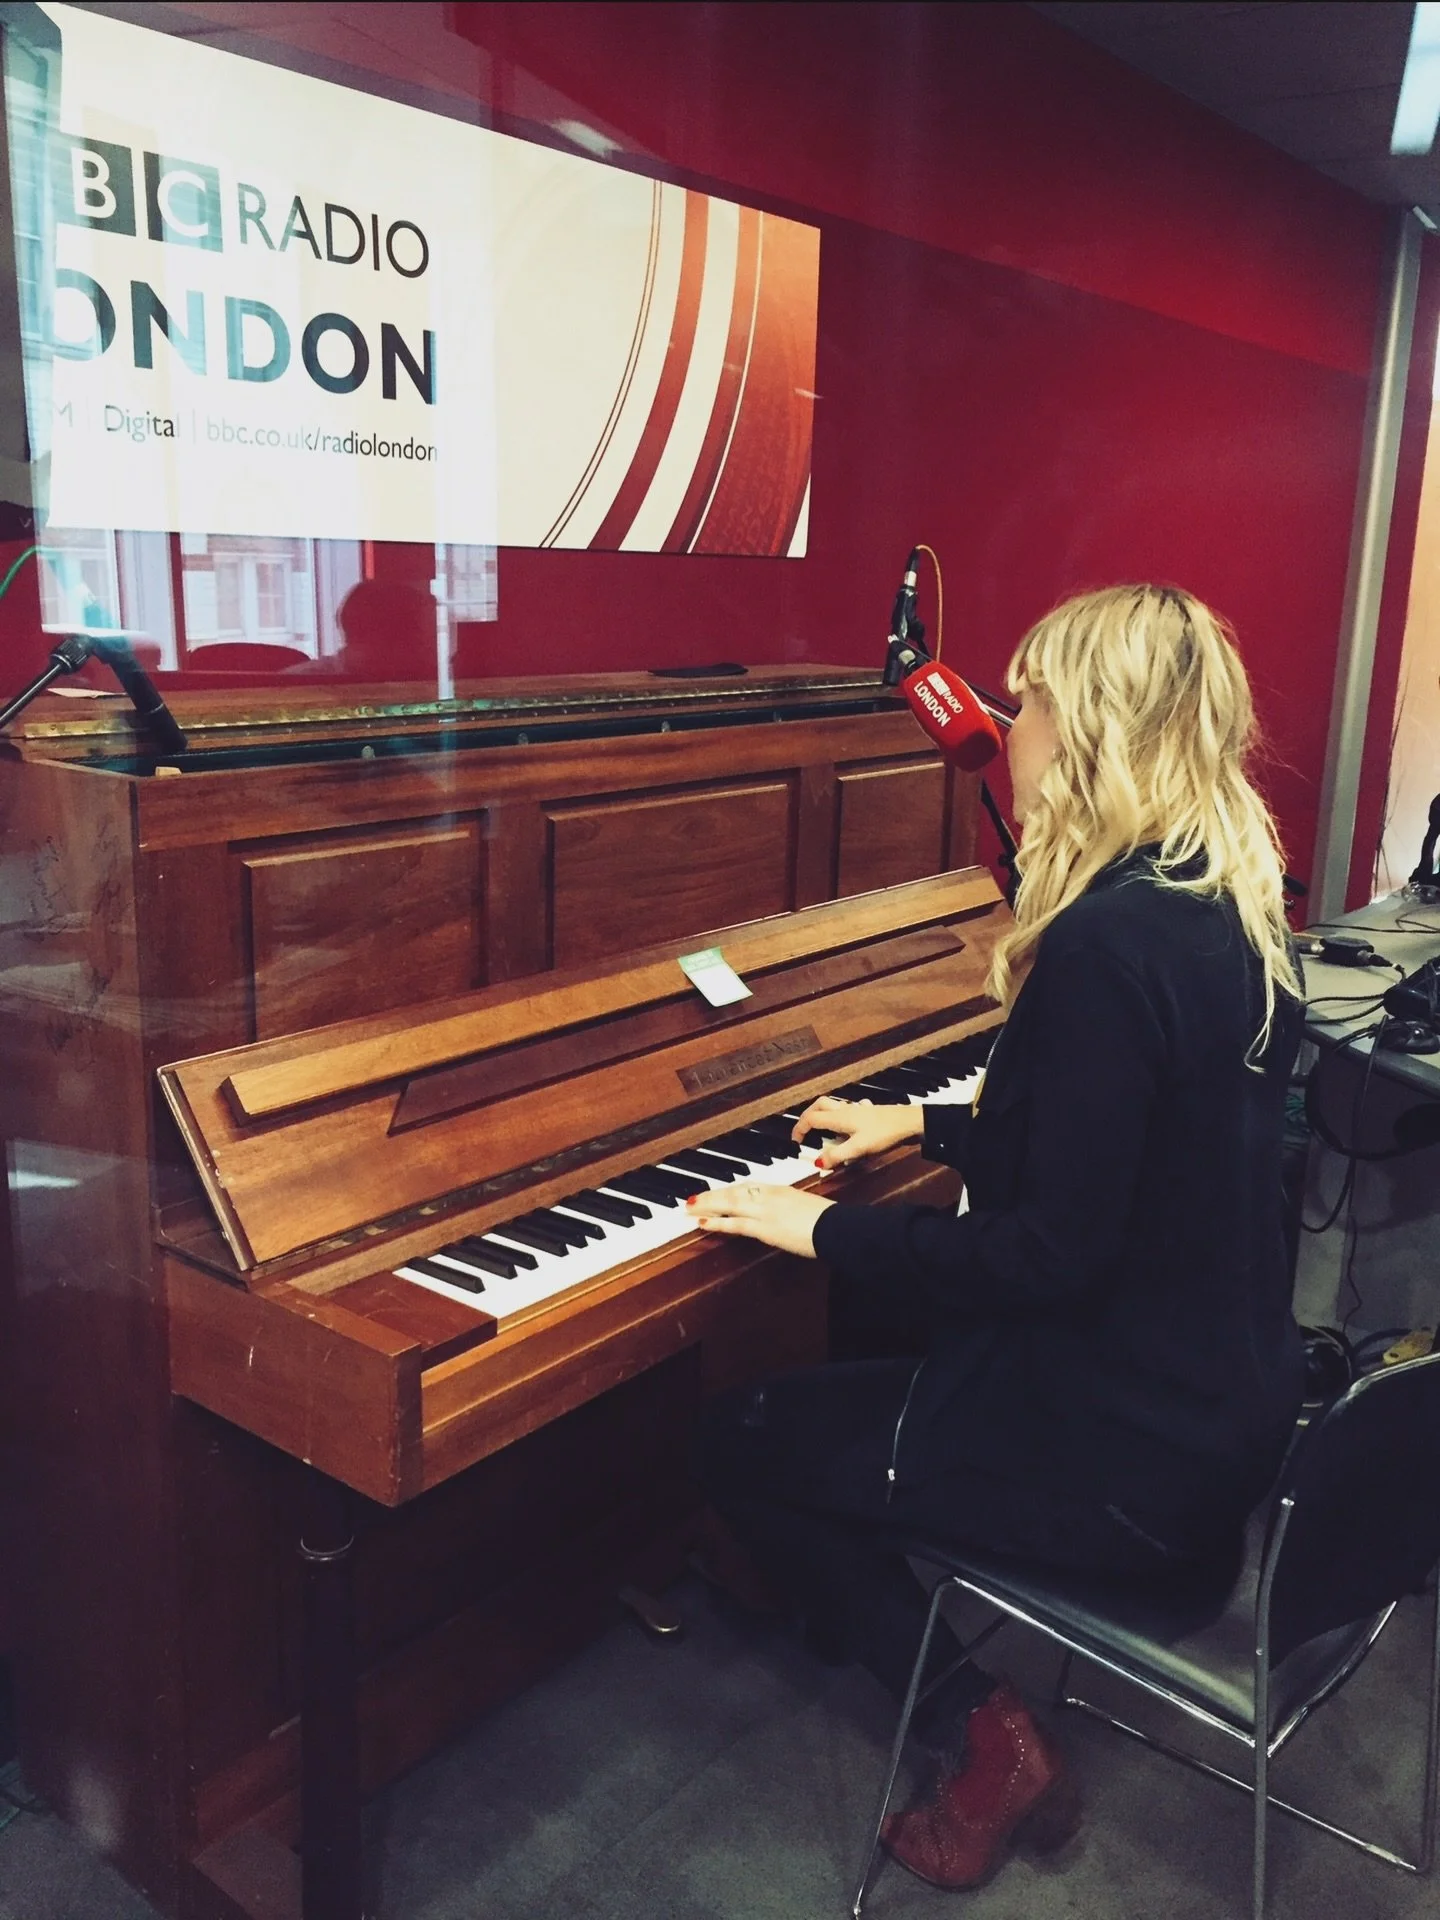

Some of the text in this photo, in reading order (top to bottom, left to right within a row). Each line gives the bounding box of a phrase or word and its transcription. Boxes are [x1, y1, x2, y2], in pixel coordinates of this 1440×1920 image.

[237, 182, 430, 279] RADIO
[104, 404, 180, 443] Digital
[206, 415, 438, 462] bbc.co.uk/radiolondon
[913, 681, 951, 727] LONDON
[942, 690, 964, 714] RADIO
